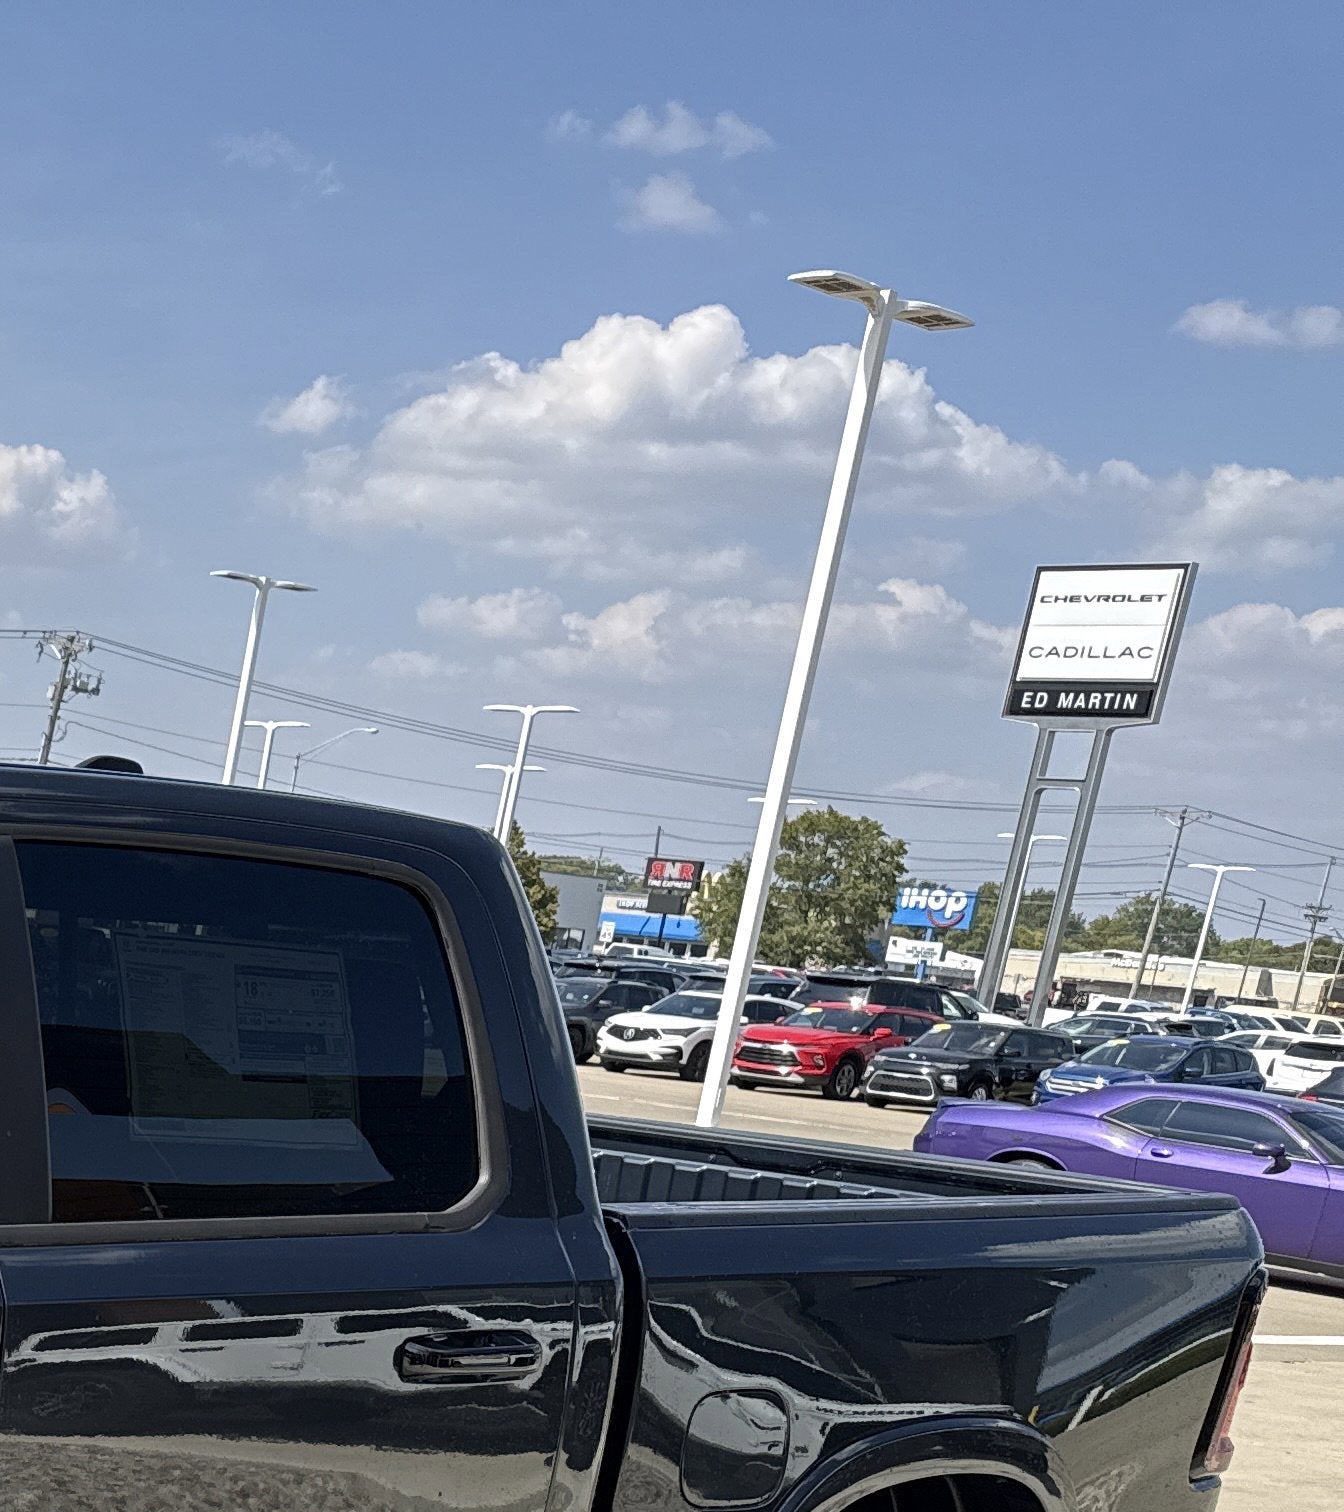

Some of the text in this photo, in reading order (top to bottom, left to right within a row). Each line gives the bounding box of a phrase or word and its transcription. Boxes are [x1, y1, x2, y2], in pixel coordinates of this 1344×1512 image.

[1040, 593, 1168, 604] CHEVROLET
[1028, 645, 1154, 659] CADILLAC
[1020, 691, 1138, 710] ED MARTIN
